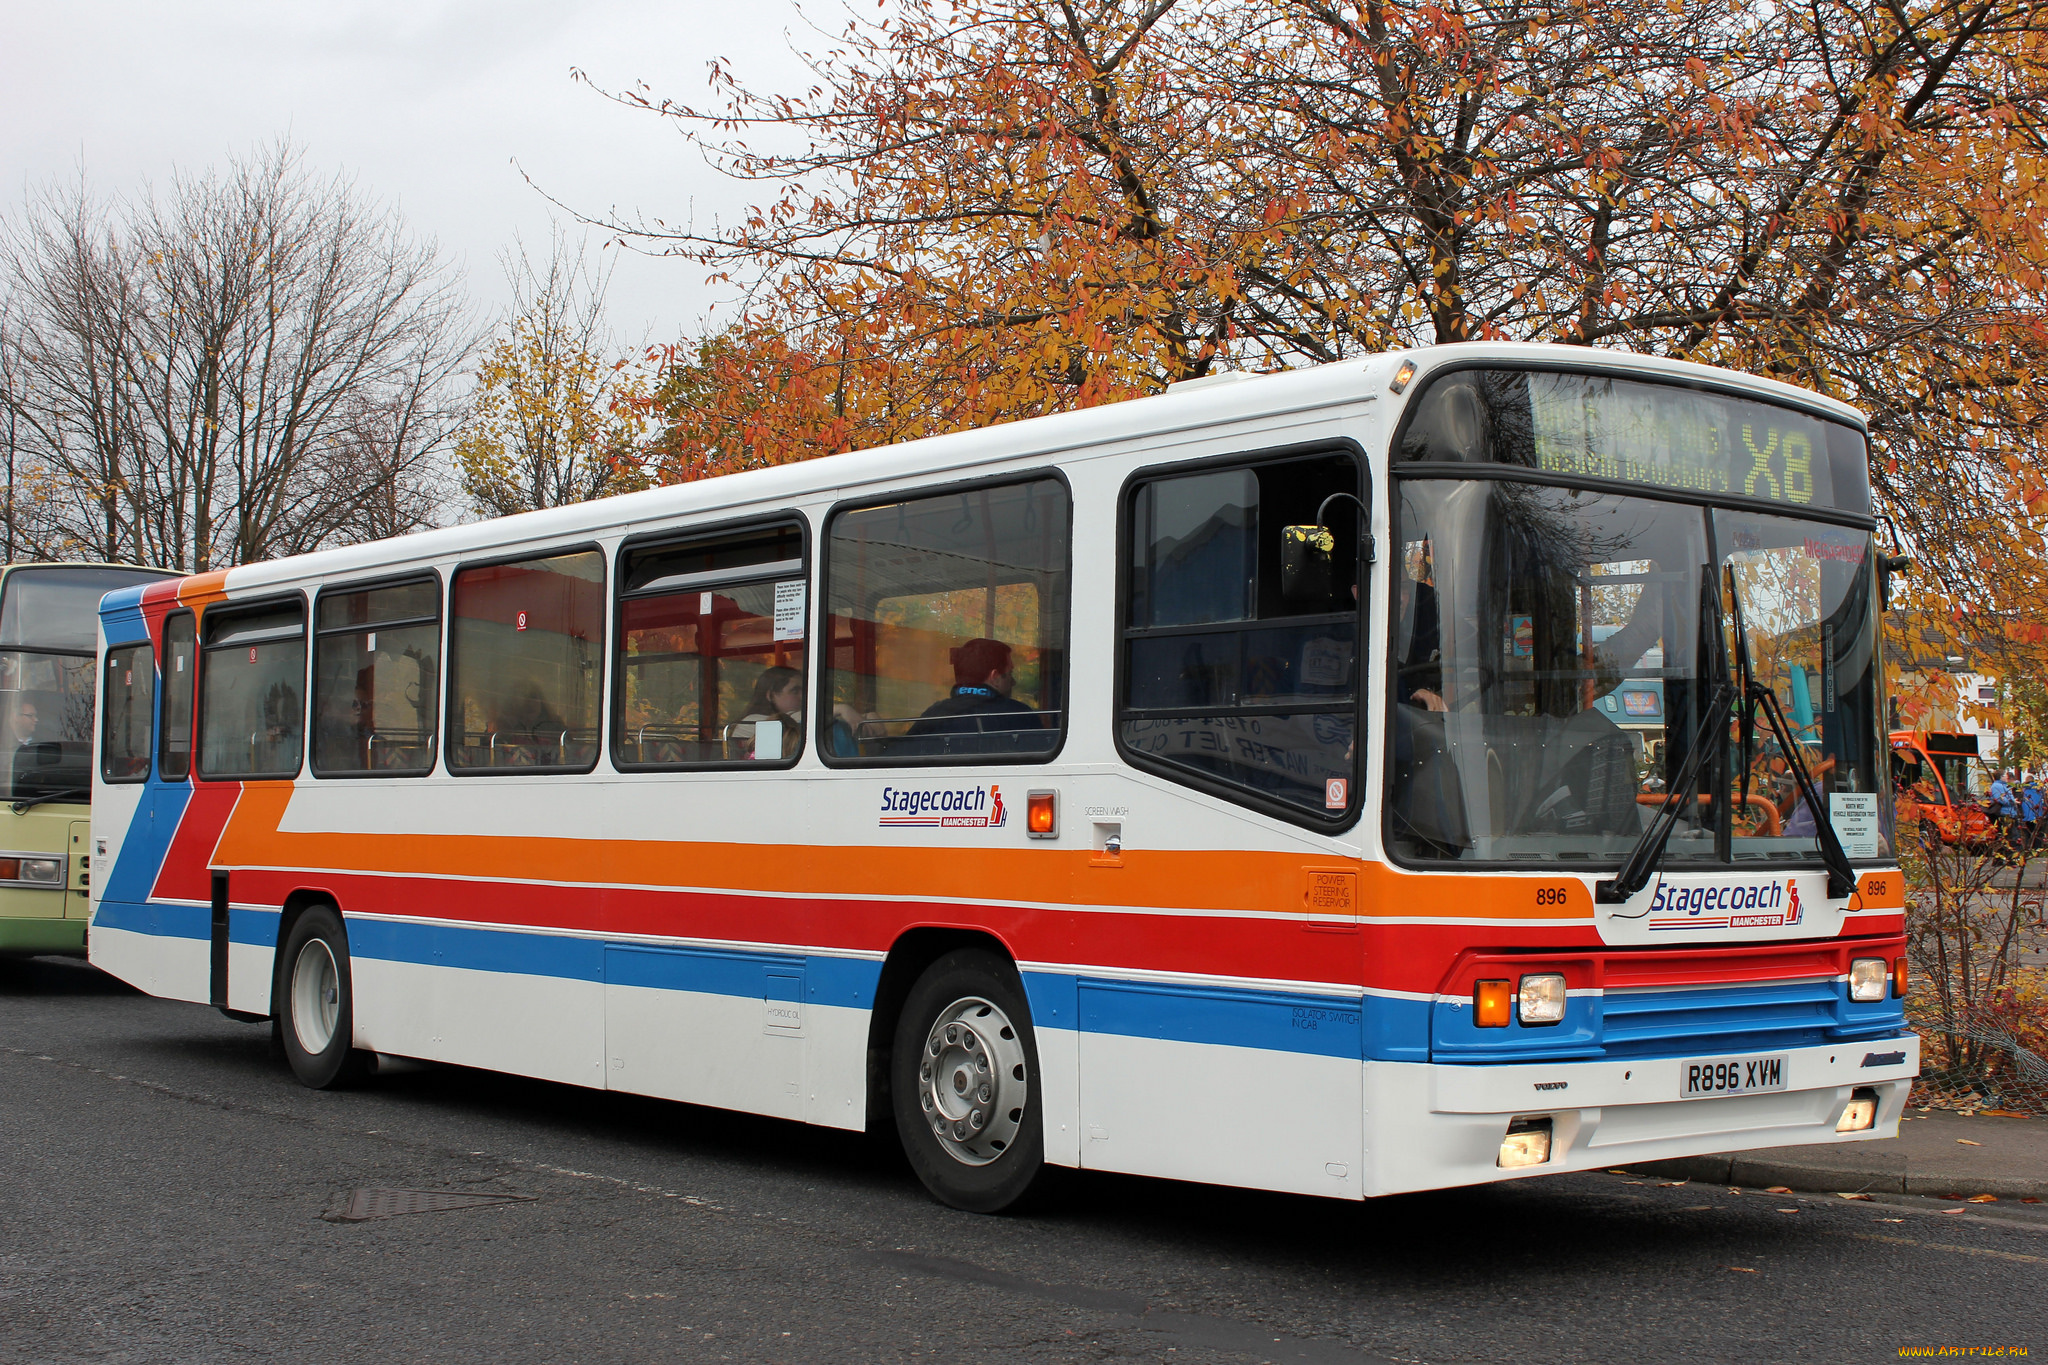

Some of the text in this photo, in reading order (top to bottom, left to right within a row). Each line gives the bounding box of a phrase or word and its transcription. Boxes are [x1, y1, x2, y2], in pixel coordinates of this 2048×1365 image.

[1742, 424, 1813, 503] X8
[881, 786, 986, 815] Stagecoach
[1085, 807, 1129, 816] SCREEN WASH
[943, 817, 986, 827] MANCHESTER
[1317, 875, 1345, 885] POWER
[1313, 886, 1349, 897] STEERING
[1868, 880, 1886, 896] 896
[1313, 897, 1350, 908] RESERVOIR
[1536, 887, 1567, 906] 896
[1651, 880, 1781, 915] Stagecoach
[1732, 915, 1782, 927] MANCHESTER
[1329, 1012, 1360, 1025] SWITCH
[1301, 1020, 1318, 1030] CAB
[1688, 1059, 1781, 1093] R896 XVM
